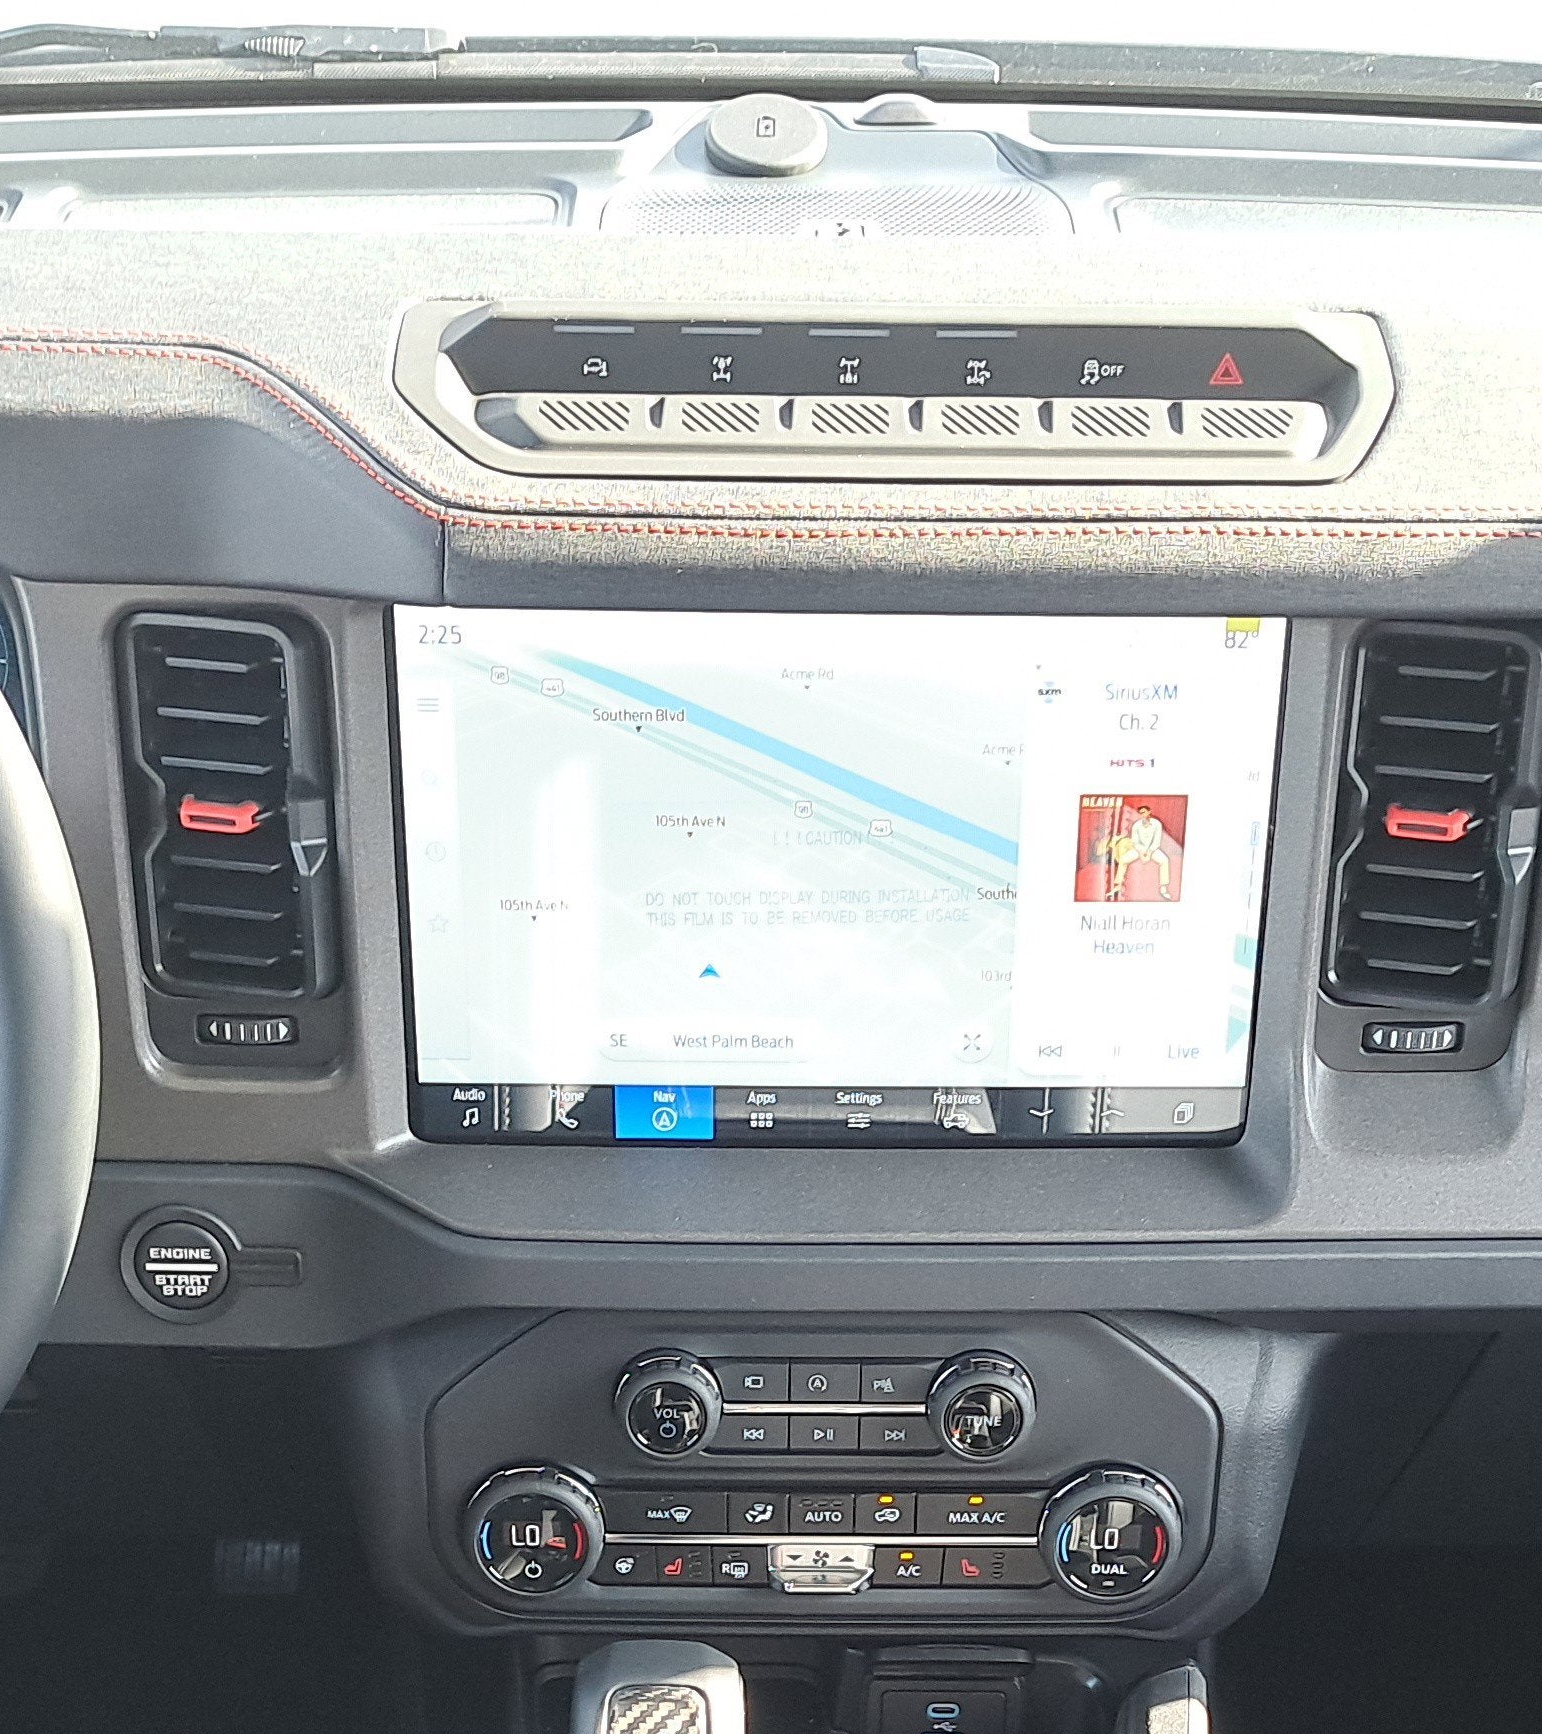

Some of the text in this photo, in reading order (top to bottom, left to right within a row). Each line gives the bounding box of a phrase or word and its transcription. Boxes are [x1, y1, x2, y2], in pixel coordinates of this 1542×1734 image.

[1100, 364, 1124, 378] OFF
[418, 624, 462, 645] 2:25
[782, 668, 815, 681] Acme
[1105, 683, 1178, 701] SiriusXM
[592, 707, 685, 722] Southern Blvd
[1119, 714, 1160, 731] Ch. 2
[655, 815, 726, 828] 105th Ave N
[499, 899, 533, 912] 105th
[1080, 915, 1171, 931] Niall Horan
[1092, 939, 1155, 955] Heaven
[609, 1033, 628, 1047] SE
[672, 1034, 794, 1049] West Palm Beach
[1167, 1043, 1200, 1060] Live
[452, 1087, 486, 1102] Audio
[549, 1088, 585, 1103] Phone
[652, 1089, 676, 1104] Nav
[746, 1090, 777, 1106] Apps
[834, 1091, 883, 1106] Settings
[932, 1091, 982, 1106] Features
[148, 1247, 212, 1261] ENGINE
[154, 1274, 213, 1287] START
[161, 1285, 208, 1297] STOP
[652, 1406, 681, 1420] VOL
[965, 1415, 1003, 1428] TUNE
[647, 1508, 671, 1520] MAX
[804, 1510, 843, 1524] AUTO
[948, 1511, 1006, 1525] MAX A/C
[510, 1523, 541, 1548] LO
[1090, 1528, 1119, 1551] LO
[721, 1563, 731, 1576] R
[896, 1564, 922, 1578] A/C
[1091, 1563, 1129, 1576] DUAL
